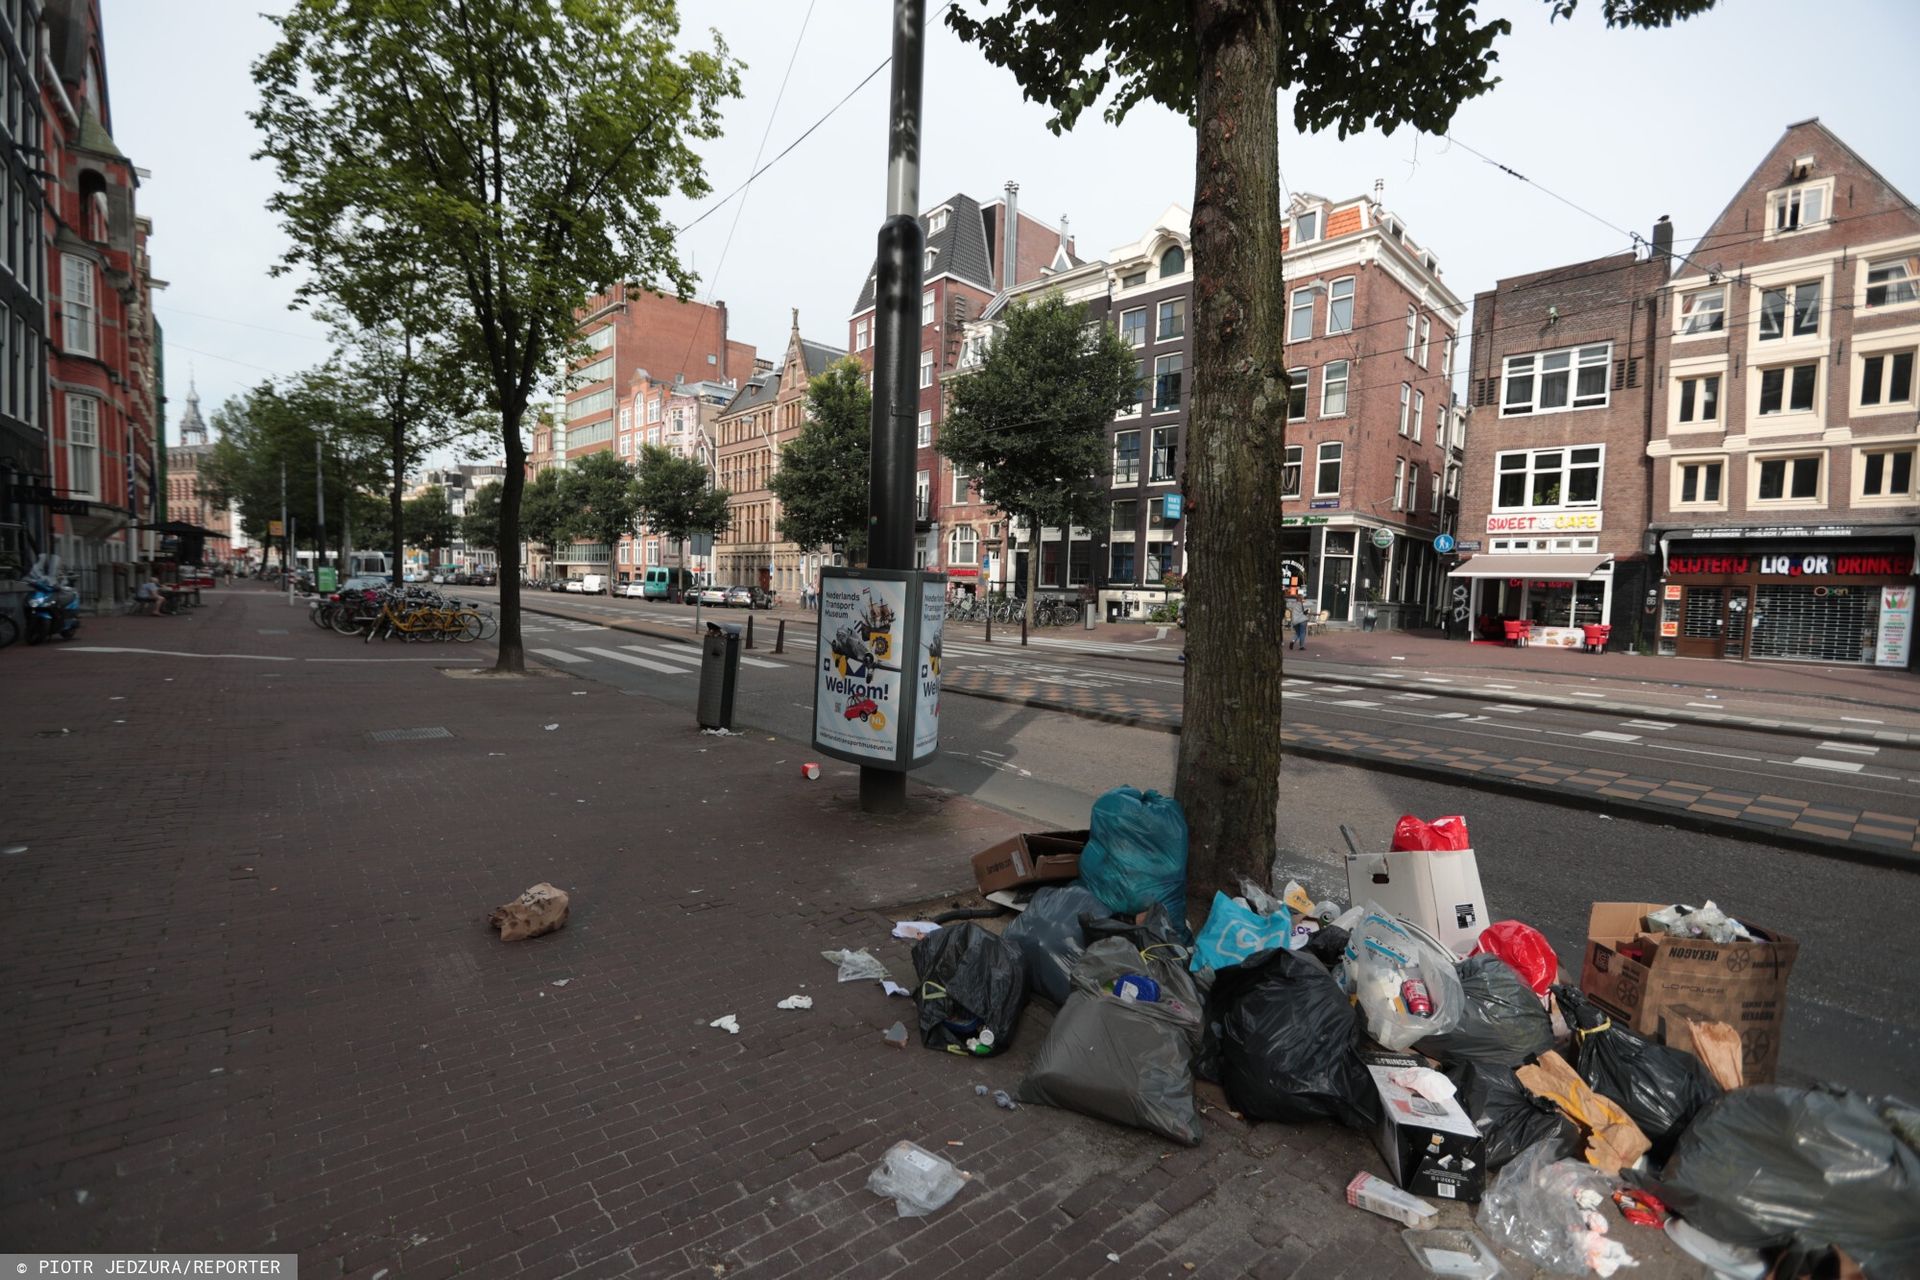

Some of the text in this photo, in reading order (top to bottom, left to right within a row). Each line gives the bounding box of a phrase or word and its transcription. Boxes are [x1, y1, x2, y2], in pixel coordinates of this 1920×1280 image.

[1487, 514, 1597, 530] SWEET & CAFE
[1669, 555, 1748, 574] SLIJTERIJ
[1761, 555, 1828, 577] LIQUOR
[825, 591, 860, 601] Nederlands
[825, 600, 855, 610] Transport
[825, 609, 849, 619] Museum
[825, 674, 889, 701] Welkom!
[1668, 946, 1719, 962] HEXAGON
[1380, 1058, 1418, 1067] PRINCESS
